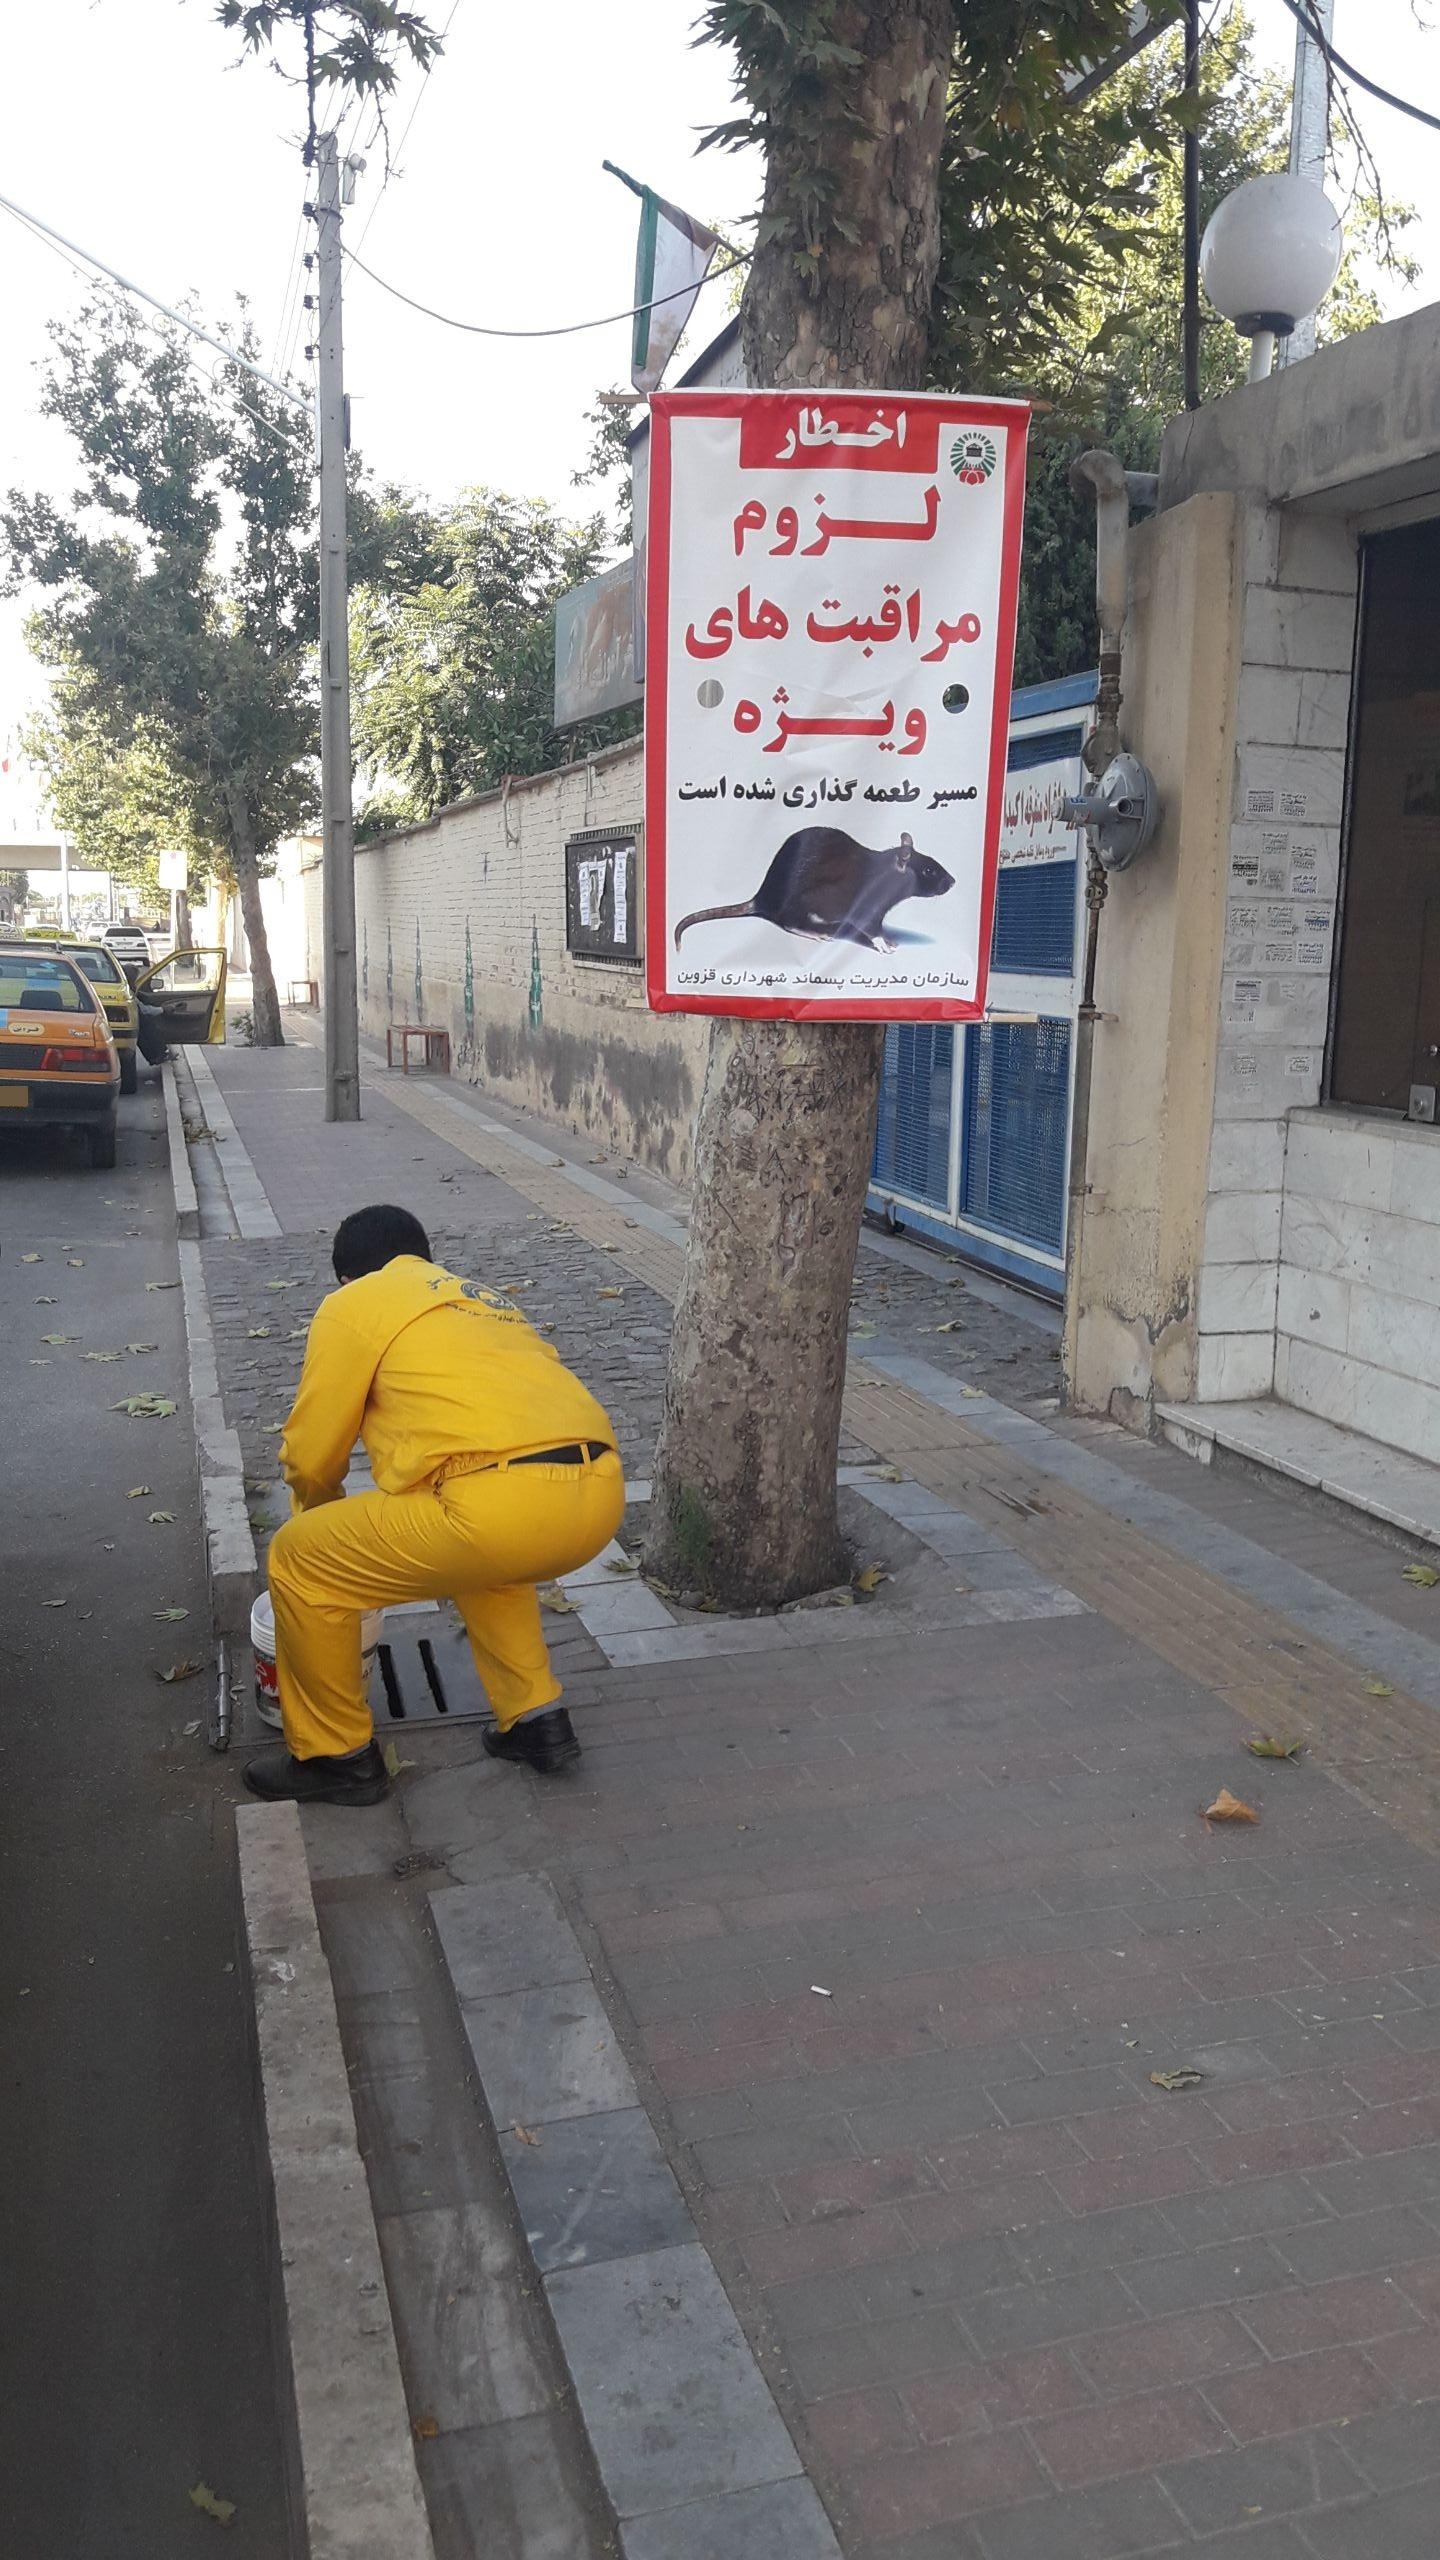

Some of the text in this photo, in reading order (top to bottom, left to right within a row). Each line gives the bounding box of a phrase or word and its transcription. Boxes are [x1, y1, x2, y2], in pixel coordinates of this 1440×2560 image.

[775, 408, 907, 460] اخطار
[733, 484, 941, 557] لزوم
[685, 583, 790, 660] های
[806, 583, 982, 663] مراقبت
[733, 684, 927, 756] ویژه
[678, 775, 978, 810] مسیر طعمه گذاری شده است
[677, 968, 969, 991] سازمان مدیریت پسماند شهرداری قزوین
